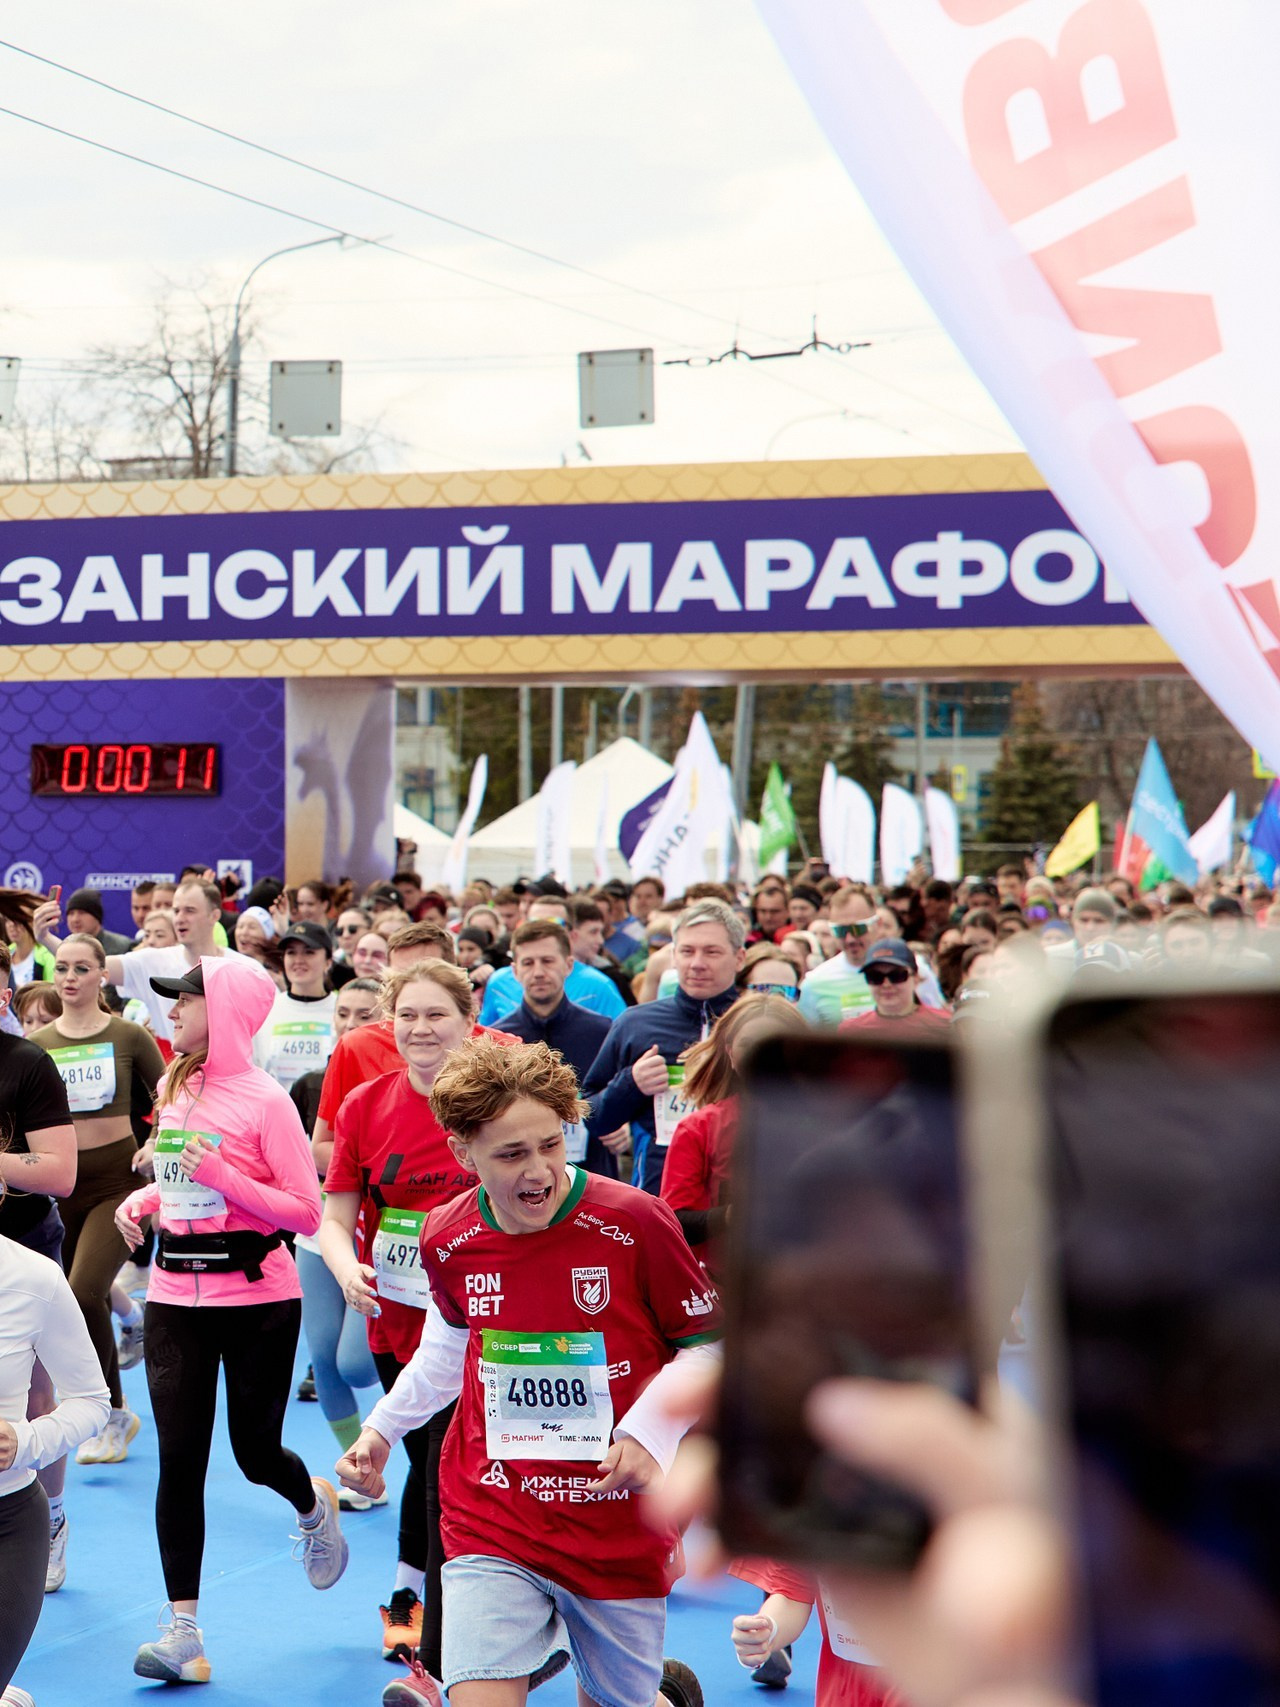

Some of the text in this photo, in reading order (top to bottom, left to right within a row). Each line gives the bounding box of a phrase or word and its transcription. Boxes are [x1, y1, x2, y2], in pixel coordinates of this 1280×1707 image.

[283, 1041, 320, 1055] 46938
[61, 1065, 102, 1084] 48148
[408, 1172, 448, 1187] КАН
[387, 1243, 425, 1269] 497
[465, 1272, 501, 1294] FON
[468, 1295, 505, 1317] BET
[483, 1366, 496, 1375] 2026
[489, 1379, 497, 1403] 12:20
[507, 1378, 588, 1408] 48888
